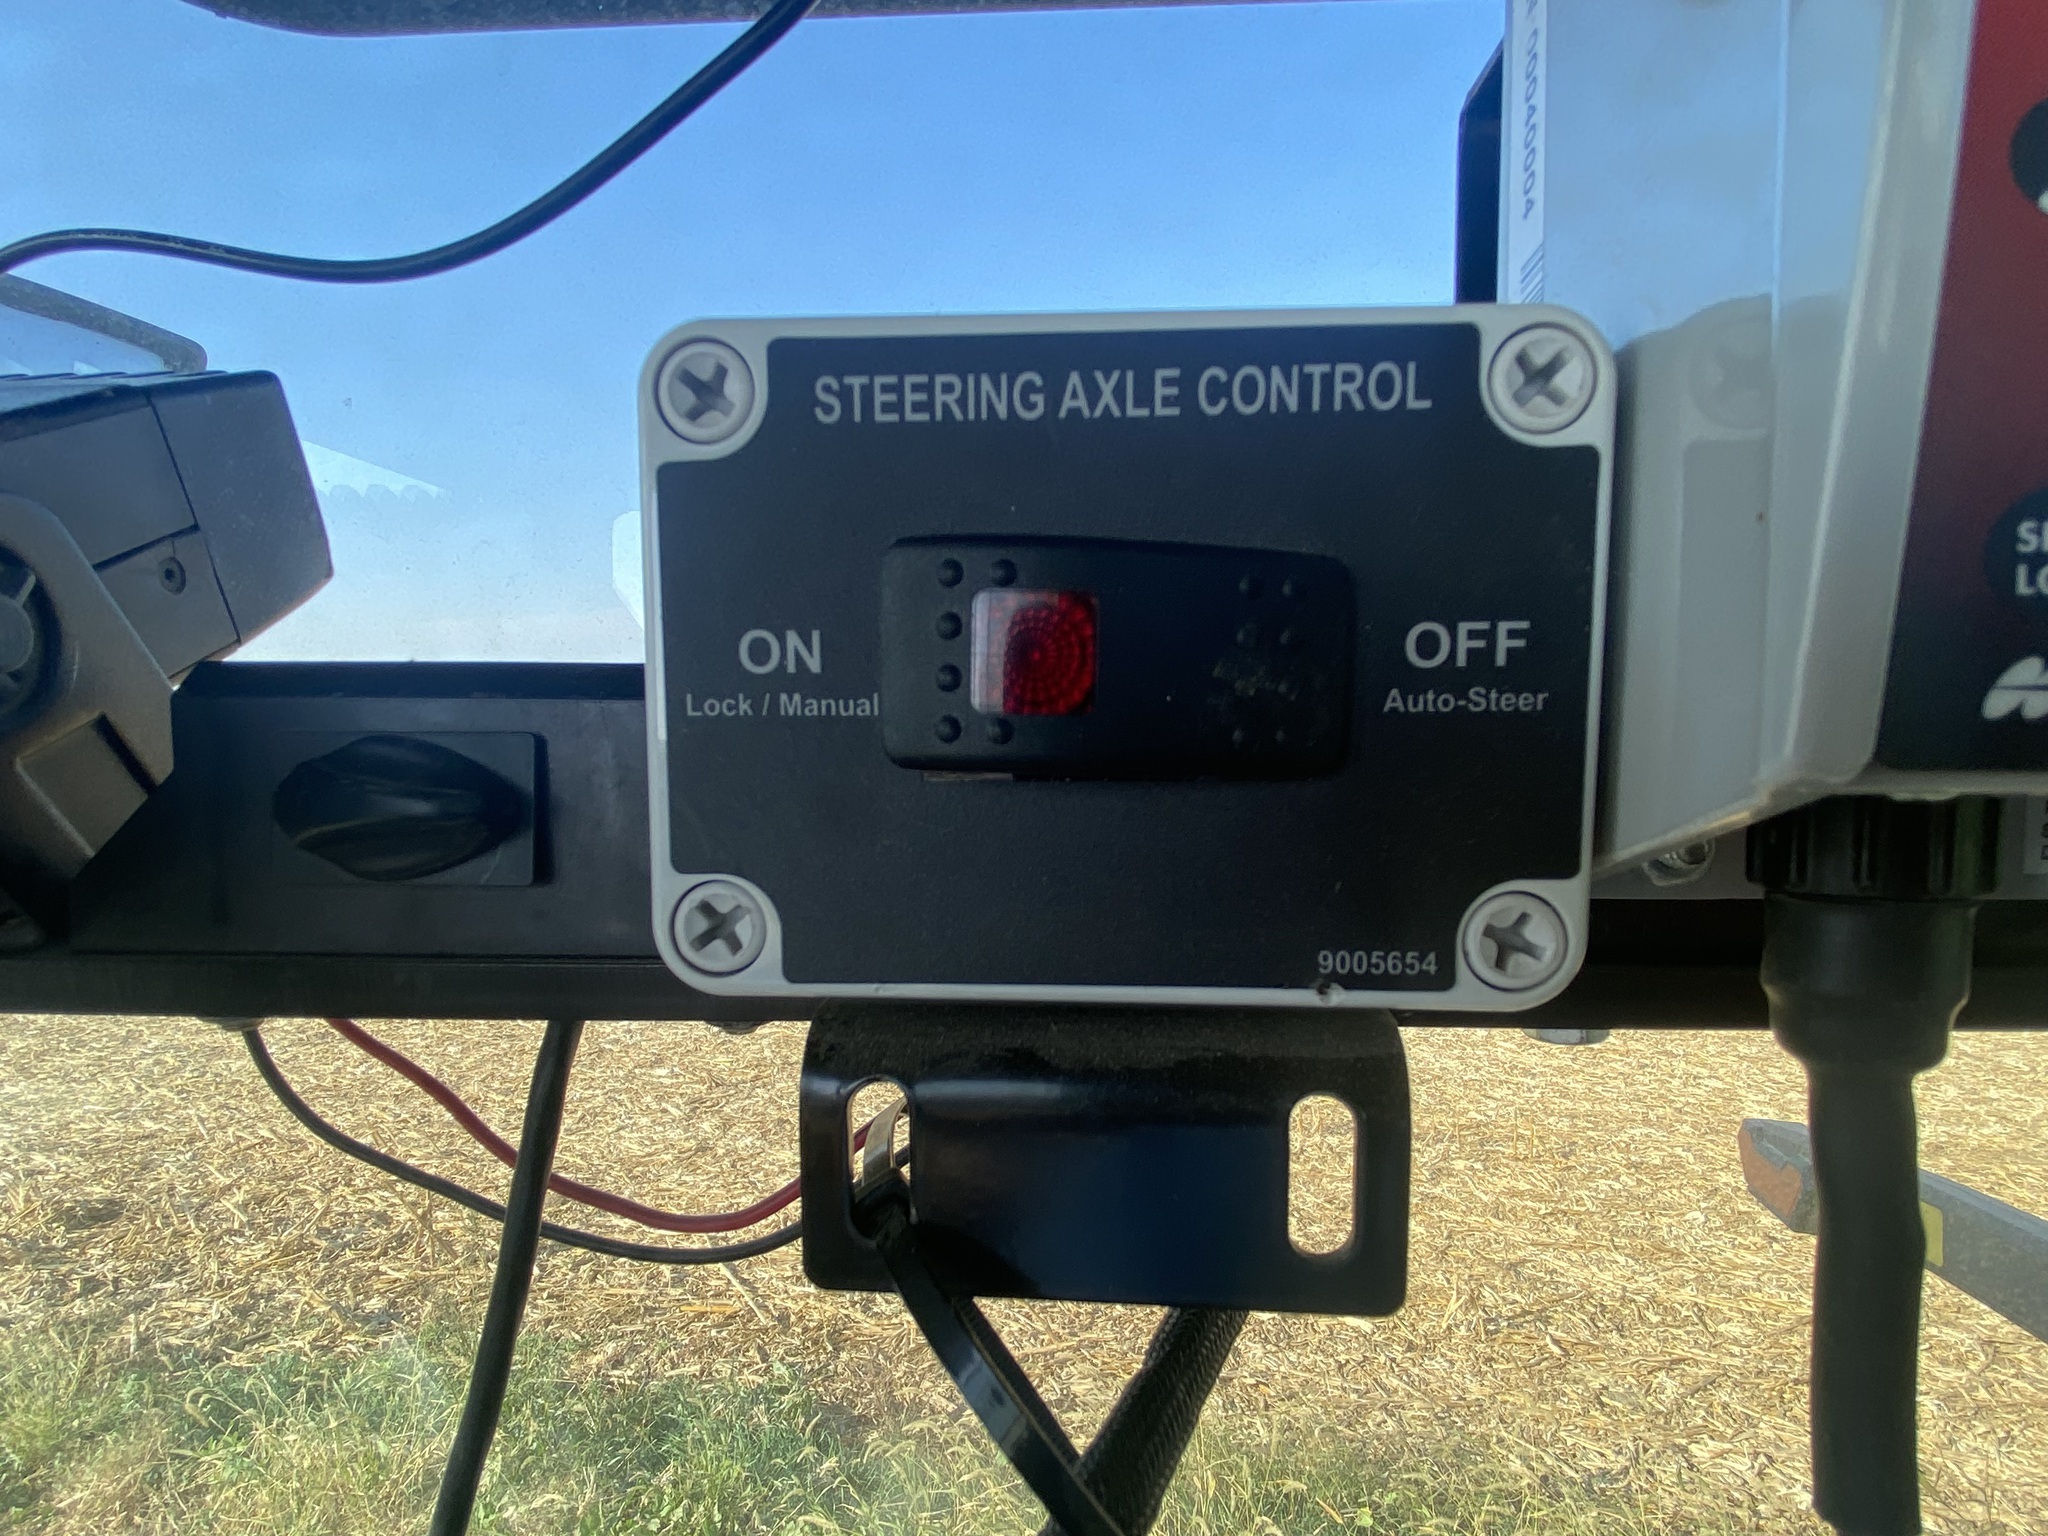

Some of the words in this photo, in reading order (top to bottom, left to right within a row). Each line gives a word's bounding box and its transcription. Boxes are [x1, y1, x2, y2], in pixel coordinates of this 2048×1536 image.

[814, 371, 1046, 425] STEERING
[1058, 367, 1181, 419] AXLE
[1198, 360, 1433, 417] CONTROL
[738, 628, 822, 675] ON
[1404, 620, 1531, 669] OFF
[686, 692, 754, 716] Lock
[762, 692, 770, 716] /
[779, 692, 879, 716] Manual
[1383, 687, 1549, 713] Auto-Steer
[1318, 950, 1438, 975] 9005654
